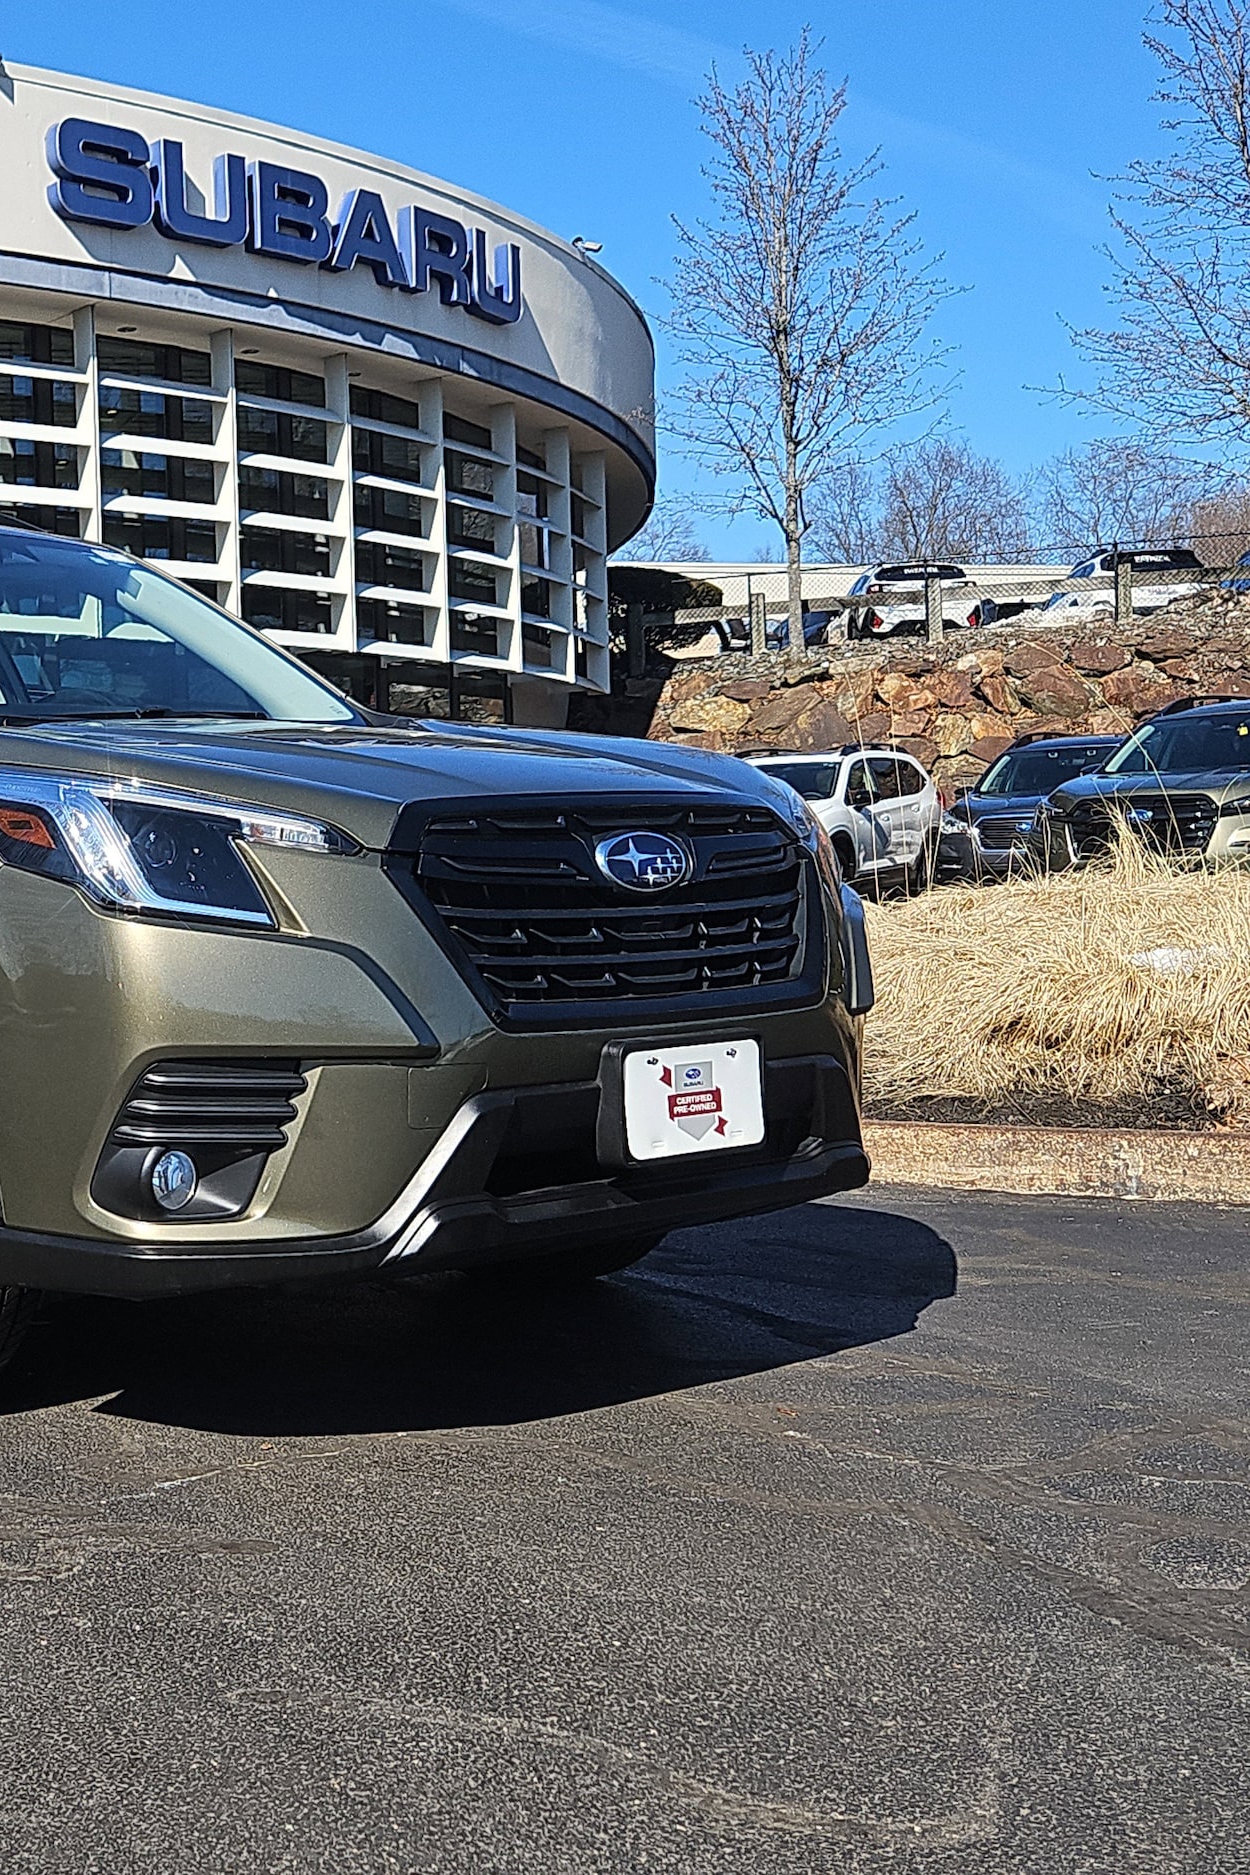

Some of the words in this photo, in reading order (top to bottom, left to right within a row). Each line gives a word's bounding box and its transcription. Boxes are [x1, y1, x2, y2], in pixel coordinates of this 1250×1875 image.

[46, 118, 522, 325] SUBARU
[676, 1094, 713, 1105] CERTIFIED
[673, 1102, 717, 1114] PRE-OWNED
